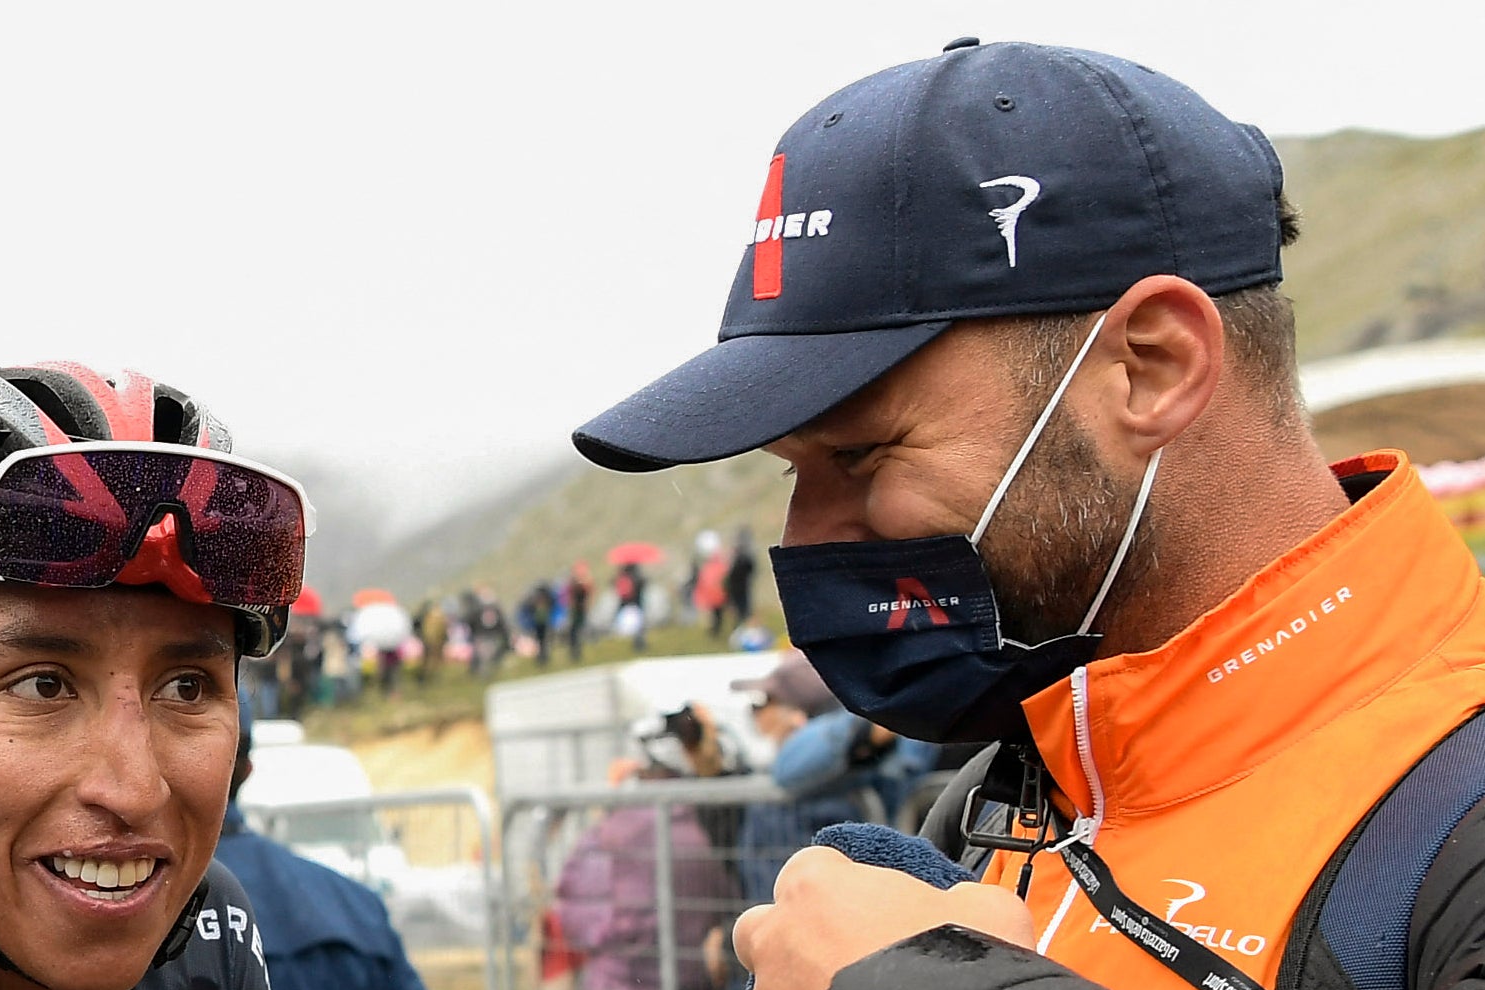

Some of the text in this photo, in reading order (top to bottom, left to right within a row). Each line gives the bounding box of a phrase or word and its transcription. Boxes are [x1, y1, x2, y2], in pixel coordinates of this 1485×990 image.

[868, 596, 960, 613] GRENADIER
[1207, 586, 1353, 684] GRENADIER
[1089, 914, 1266, 957] PELLO
